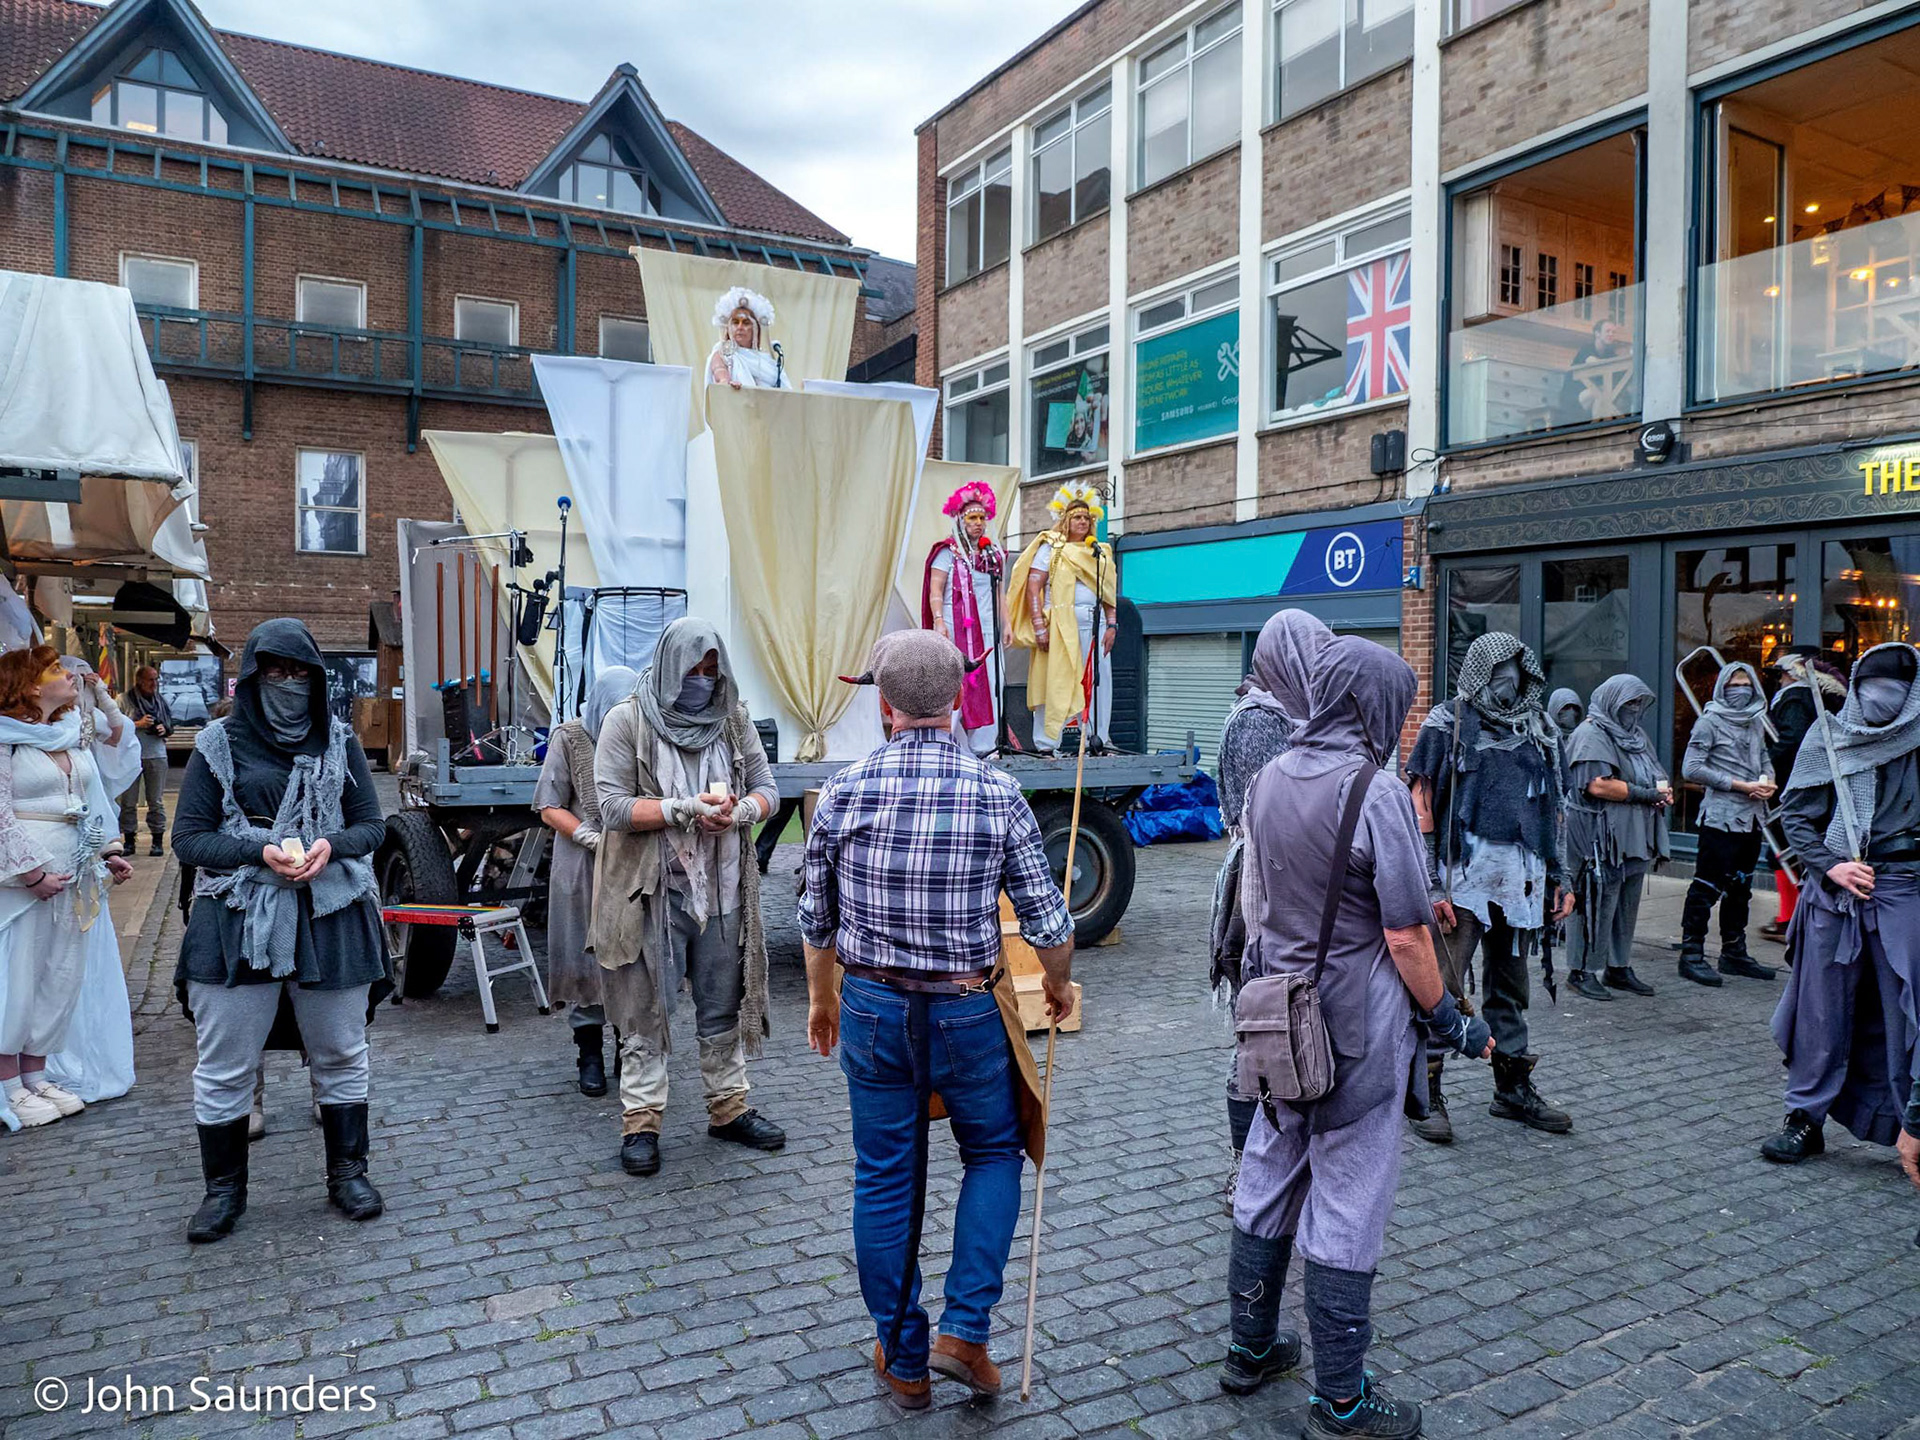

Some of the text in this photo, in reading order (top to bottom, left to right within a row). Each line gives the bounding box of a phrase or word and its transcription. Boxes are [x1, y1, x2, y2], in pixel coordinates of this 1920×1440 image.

[1161, 405, 1194, 421] SAMSUNG
[1858, 457, 1920, 496] THE
[1334, 548, 1356, 570] BT
